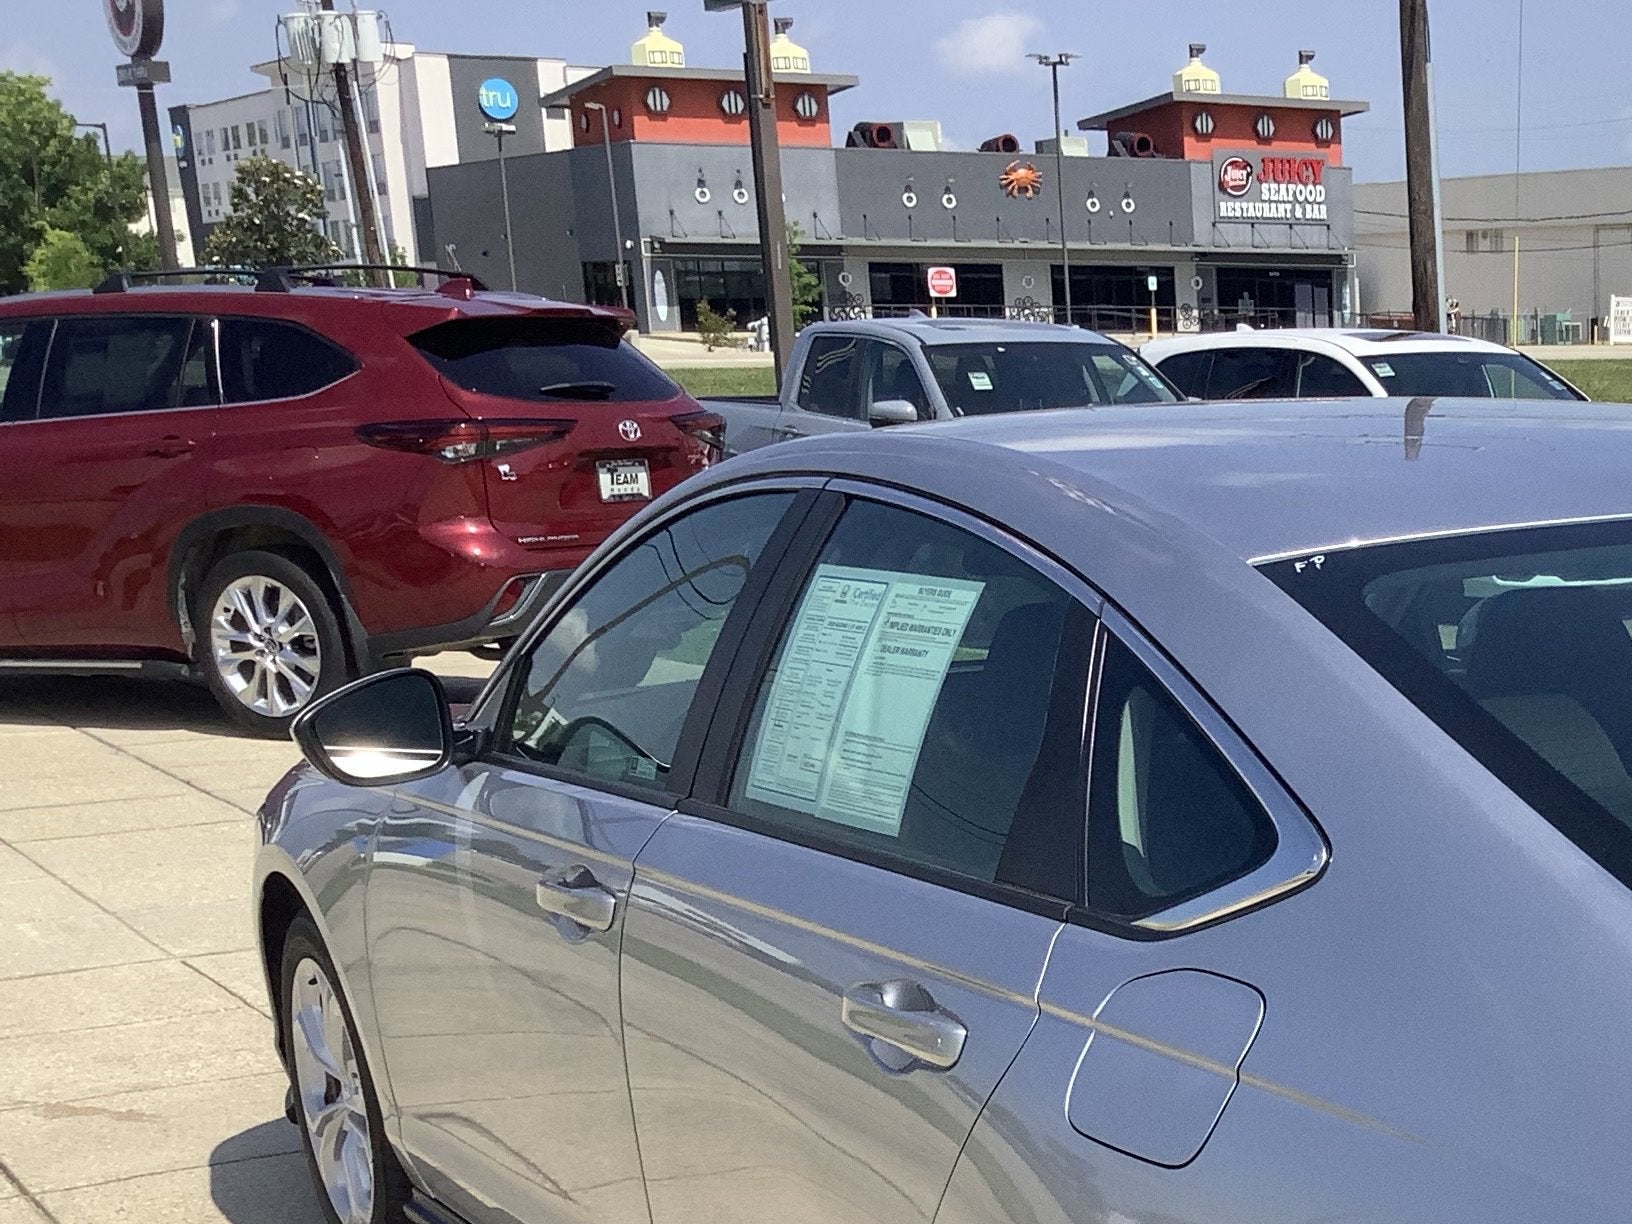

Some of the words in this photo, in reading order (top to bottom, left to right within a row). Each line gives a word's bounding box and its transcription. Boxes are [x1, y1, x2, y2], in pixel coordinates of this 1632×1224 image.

[480, 86, 511, 108] tru
[1257, 157, 1324, 184] JUICY
[1261, 183, 1325, 203] SEAFOOD
[1219, 201, 1292, 219] RESTAURANT
[1294, 203, 1303, 219] &
[1305, 204, 1328, 220] BAR
[606, 467, 639, 485] TEAM
